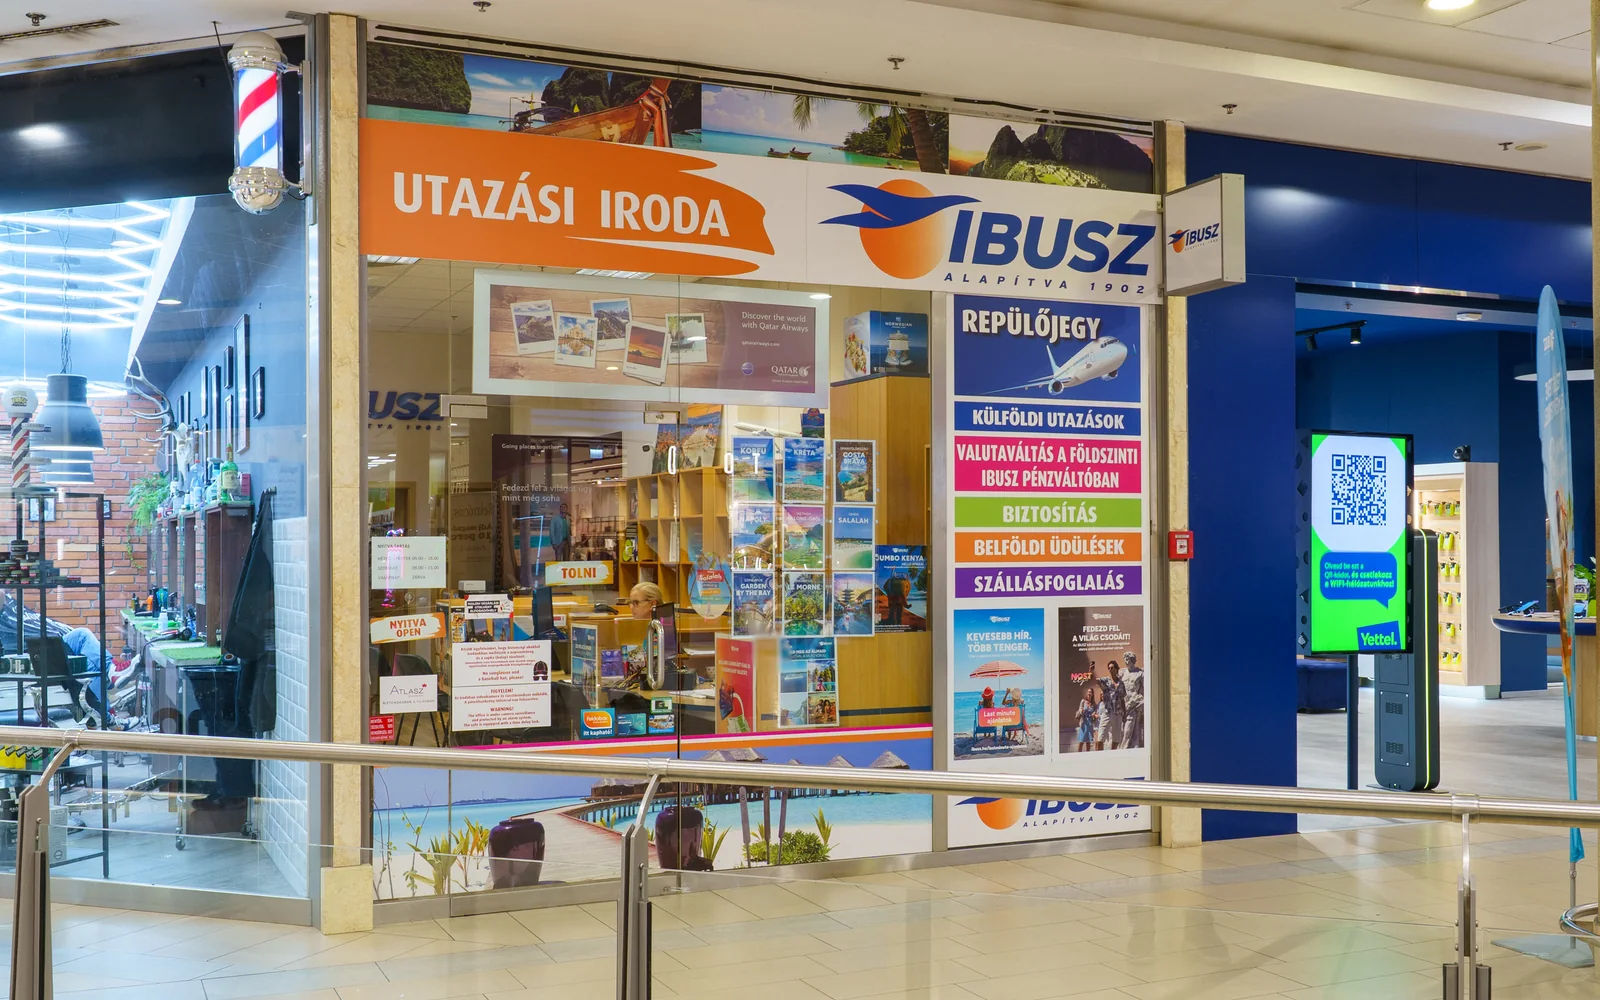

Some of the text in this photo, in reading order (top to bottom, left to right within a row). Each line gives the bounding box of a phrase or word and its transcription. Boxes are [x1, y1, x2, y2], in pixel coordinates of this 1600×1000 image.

[393, 171, 730, 237] UTAZÁSI IRODA
[1185, 222, 1220, 246] IBUSZ
[948, 209, 1157, 276] IBUSZ
[944, 272, 1145, 294] ALAPÍTVA 1902
[742, 312, 771, 320] Discover
[760, 322, 779, 330] Qatar
[781, 324, 808, 333] Airways
[962, 306, 1101, 344] REPÜLŐJEGY
[771, 366, 798, 374] QATAR
[972, 406, 1124, 430] KÜLFÖLDI UTAZÁSOK
[794, 448, 816, 456] KRÉTA
[956, 441, 1138, 465] VALUTAVÁLTÁS A FÖLDSZINTI
[982, 466, 1119, 488] IBUSZ PÉNZVÁLTÓBAN
[502, 483, 530, 492] Fedezd
[531, 484, 541, 492] fel
[522, 494, 540, 504] még
[1002, 501, 1098, 524] BIZTOSÍTÁS
[974, 534, 1124, 556] BELFÖLDI ÜDÜLÉSEK
[562, 567, 597, 579] TOLNI
[974, 570, 1124, 593] SZÁLLÁSFOGLALÁS
[390, 618, 426, 630] NYITVA
[396, 628, 421, 638] OPEN
[966, 629, 1032, 641] KEVESEBB HÍR.
[1100, 632, 1130, 640] CSODÁIT!
[1360, 632, 1398, 646] Yettel.
[968, 641, 1032, 652] TÖBB TENGER.
[1023, 812, 1139, 828] ALAPÍTVA 1902
